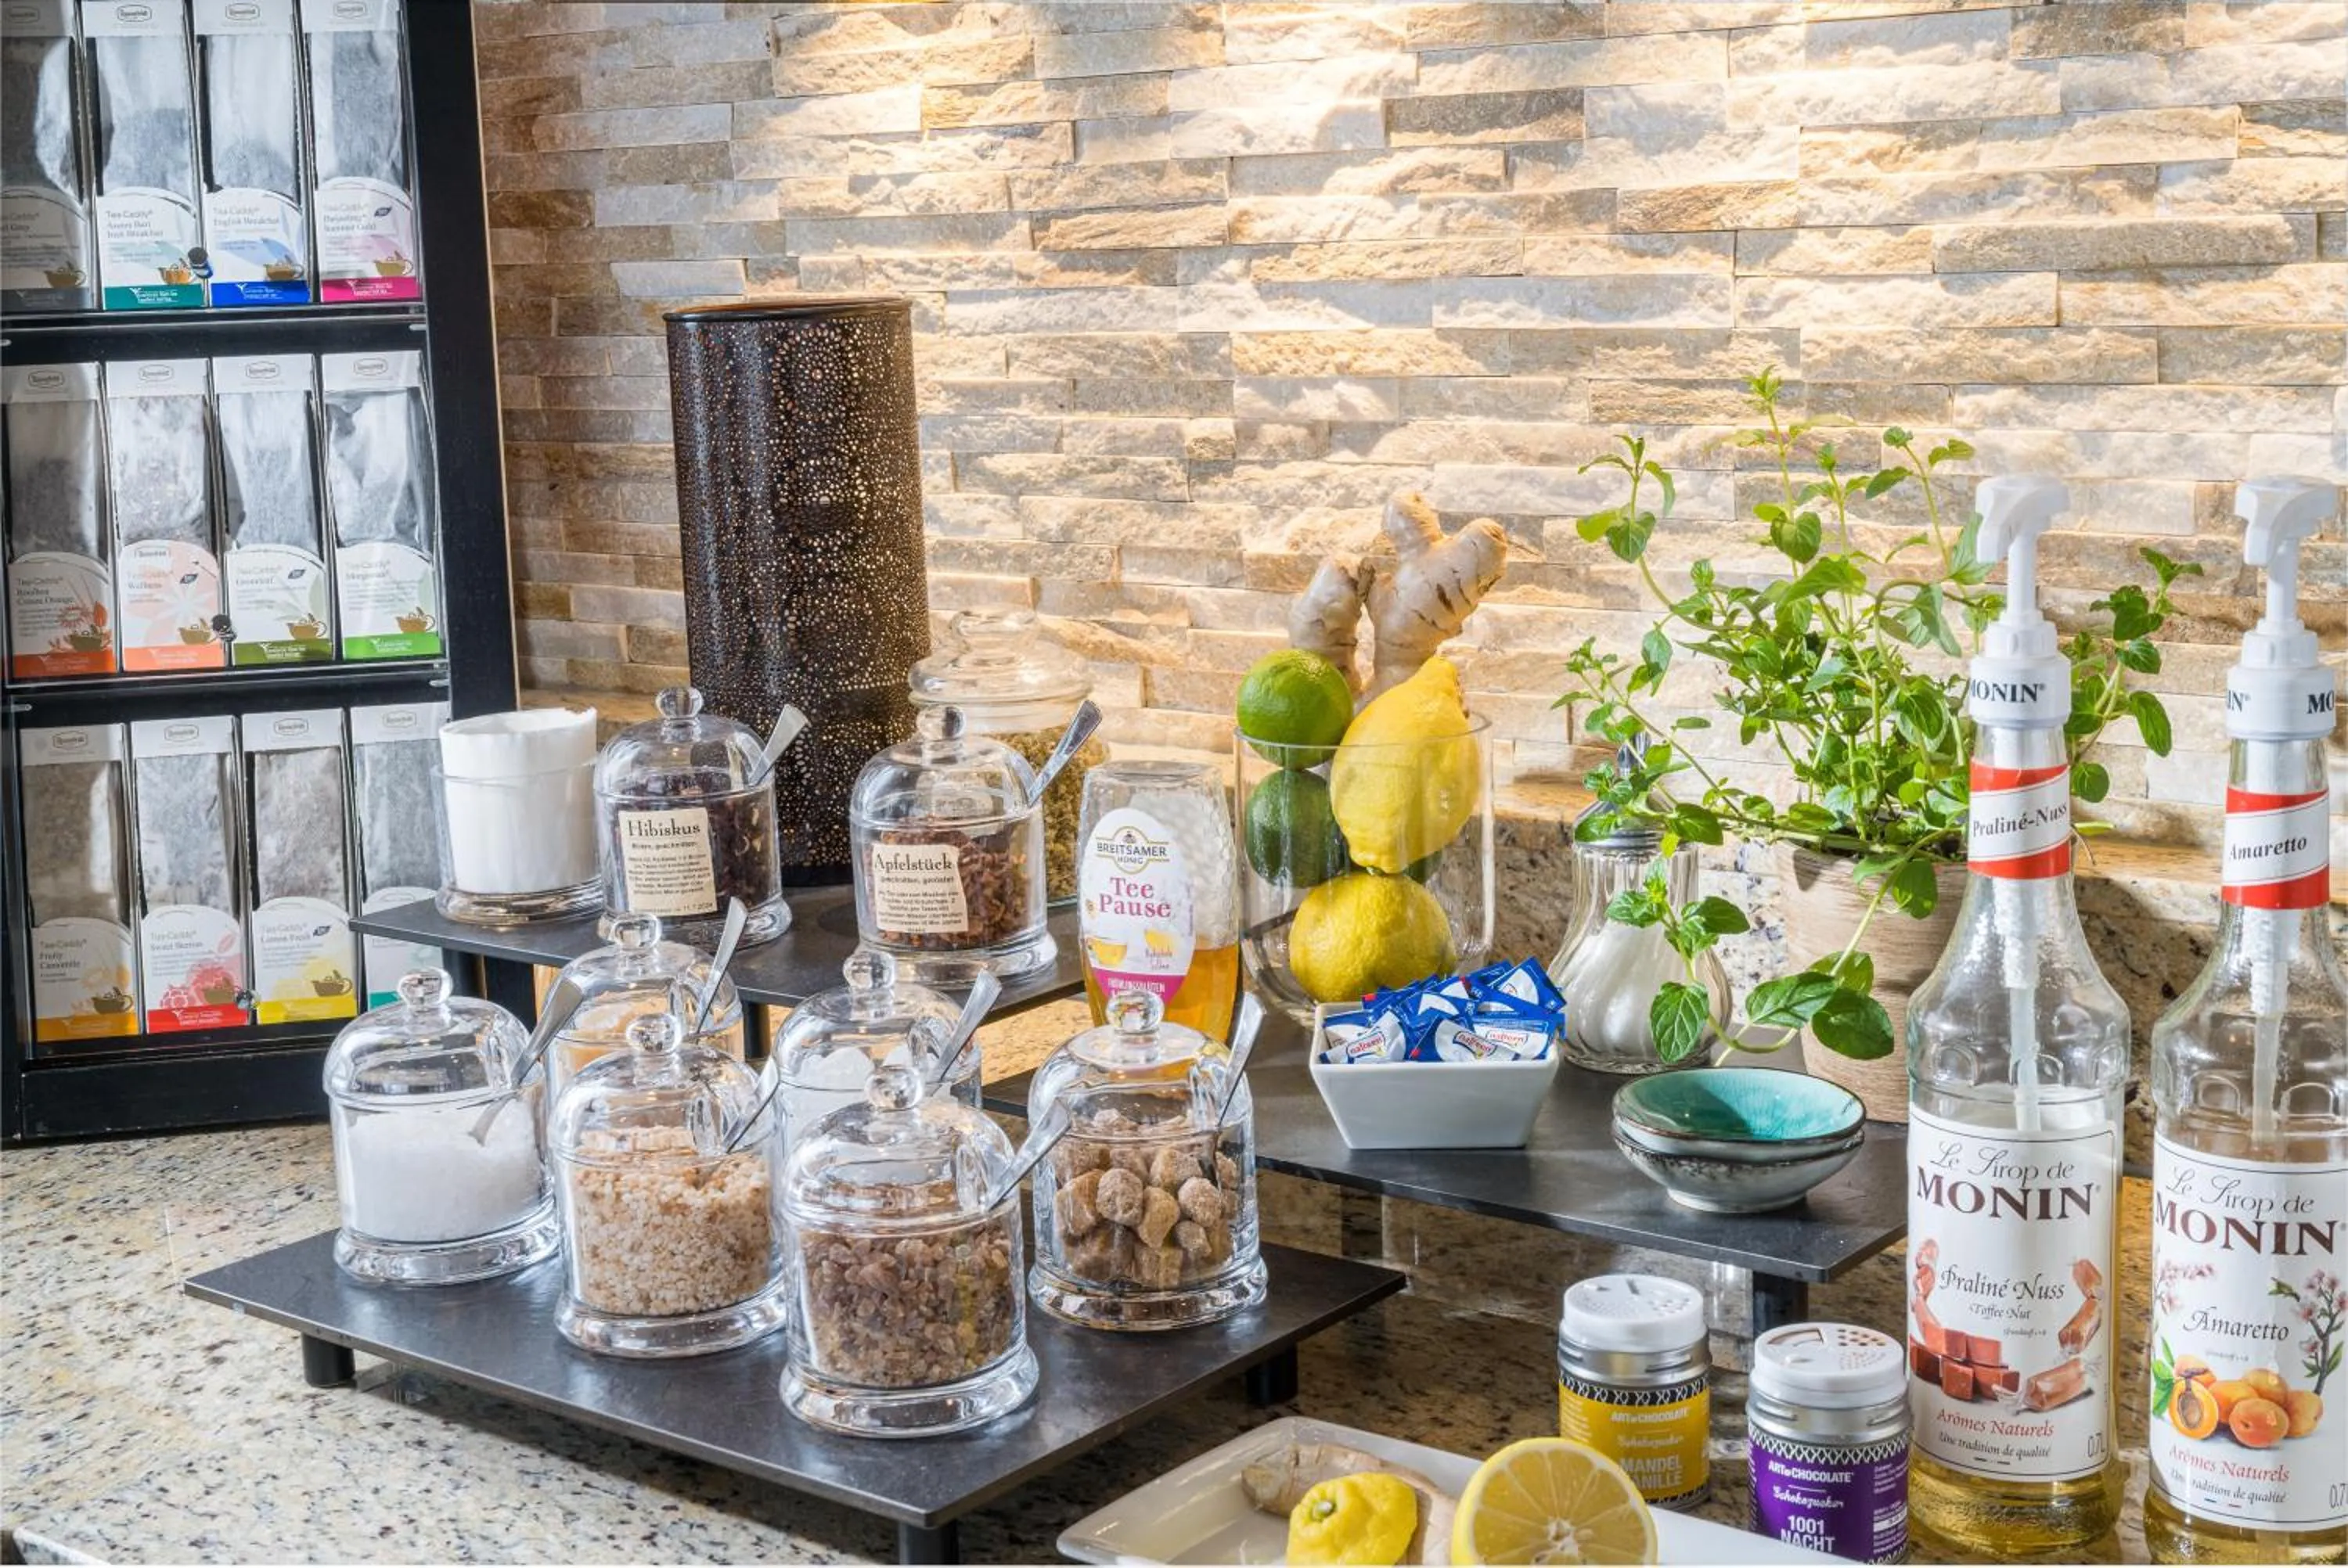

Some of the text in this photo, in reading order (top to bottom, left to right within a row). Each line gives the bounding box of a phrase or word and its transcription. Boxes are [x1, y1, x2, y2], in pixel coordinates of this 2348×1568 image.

[628, 818, 701, 837] Hibiskus
[1972, 802, 2067, 838] Praliné-Nuss
[1097, 842, 1168, 857] BREITSAMER
[1117, 857, 1144, 865] HONIG
[2229, 836, 2307, 861] Amaretto
[874, 852, 953, 874] Apfelstück
[1109, 877, 1154, 899] Tee
[1099, 893, 1172, 919] Pause
[1931, 1140, 2075, 1187] Le Sirop de
[1918, 1165, 2095, 1221] MONIN
[2166, 1166, 2315, 1219] Le Sirop de
[2155, 1191, 2339, 1256] MONIN
[1939, 1264, 2065, 1300] Praliné Nuss
[2182, 1307, 2290, 1342] Amaretto
[1937, 1408, 2054, 1438] Arômes Naturels
[1957, 1437, 2000, 1455] tradition
[2001, 1442, 2014, 1456] de
[2015, 1445, 2051, 1460] qualité
[1619, 1454, 1682, 1473] MANDEL
[2221, 1460, 2290, 1483] Naturels
[1633, 1471, 1683, 1490] ANILLE
[2192, 1478, 2231, 1497] radition
[2233, 1486, 2246, 1498] de
[2247, 1489, 2287, 1505] qualité
[1787, 1515, 1825, 1535] 1001
[1780, 1528, 1836, 1553] NACHT
